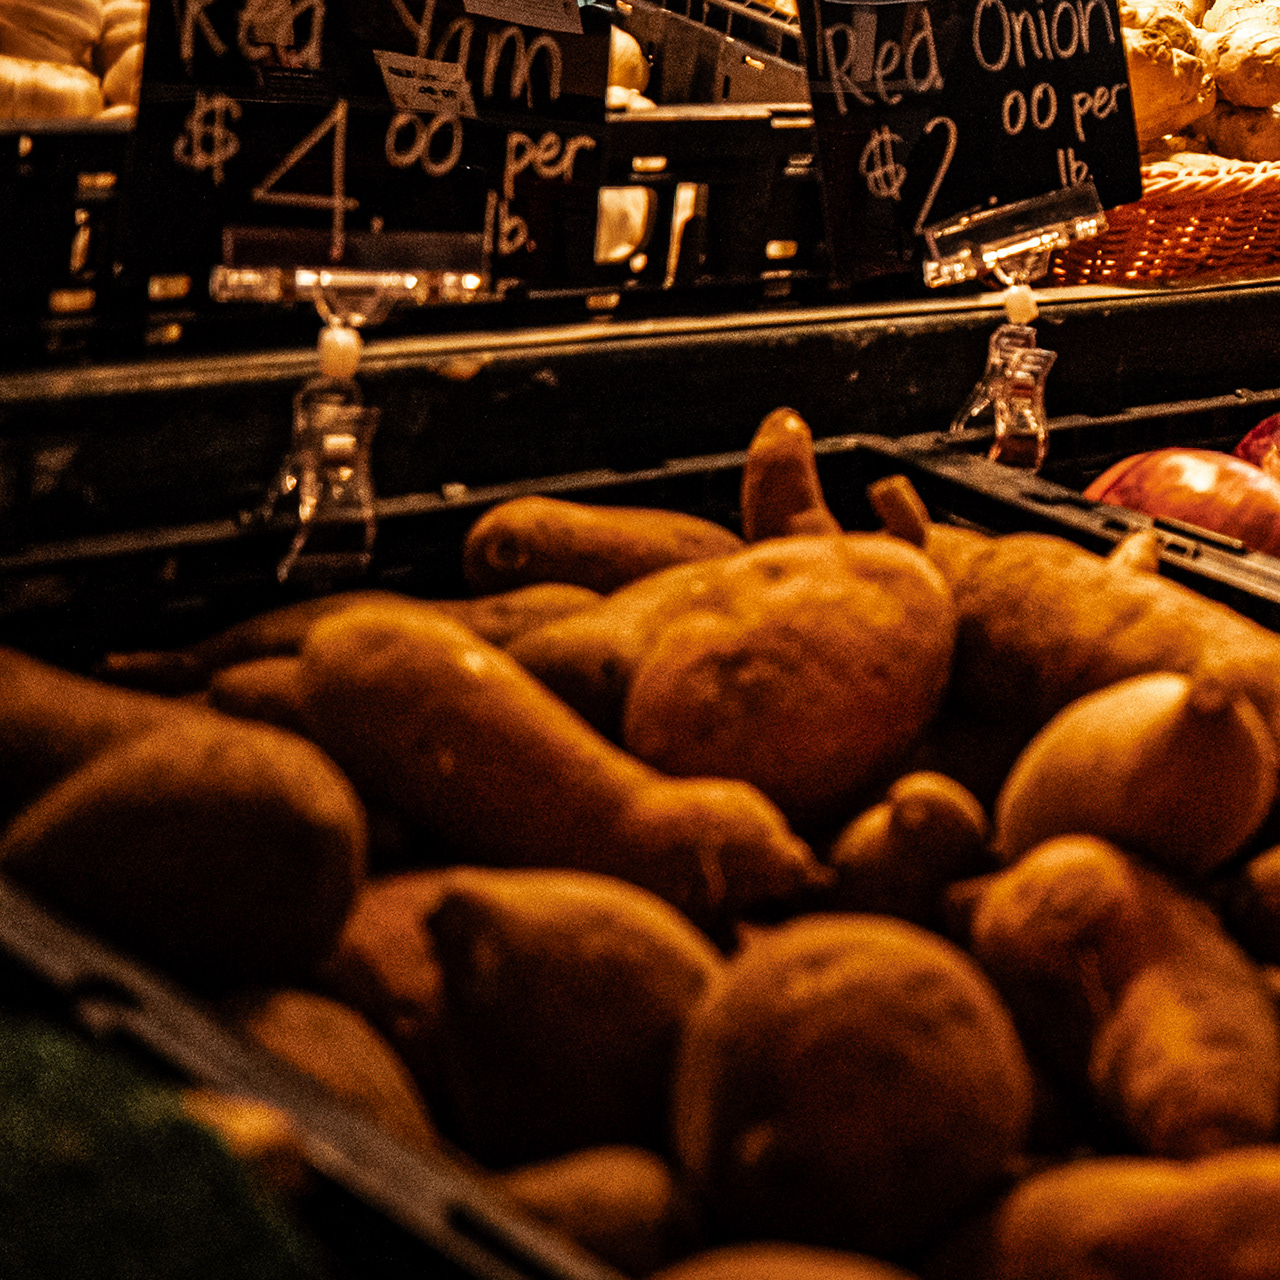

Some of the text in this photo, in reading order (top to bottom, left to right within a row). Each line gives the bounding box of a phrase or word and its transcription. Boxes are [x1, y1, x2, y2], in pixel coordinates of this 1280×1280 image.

[824, 8, 945, 115] Red
[1073, 82, 1128, 142] per
[503, 131, 597, 201] per
